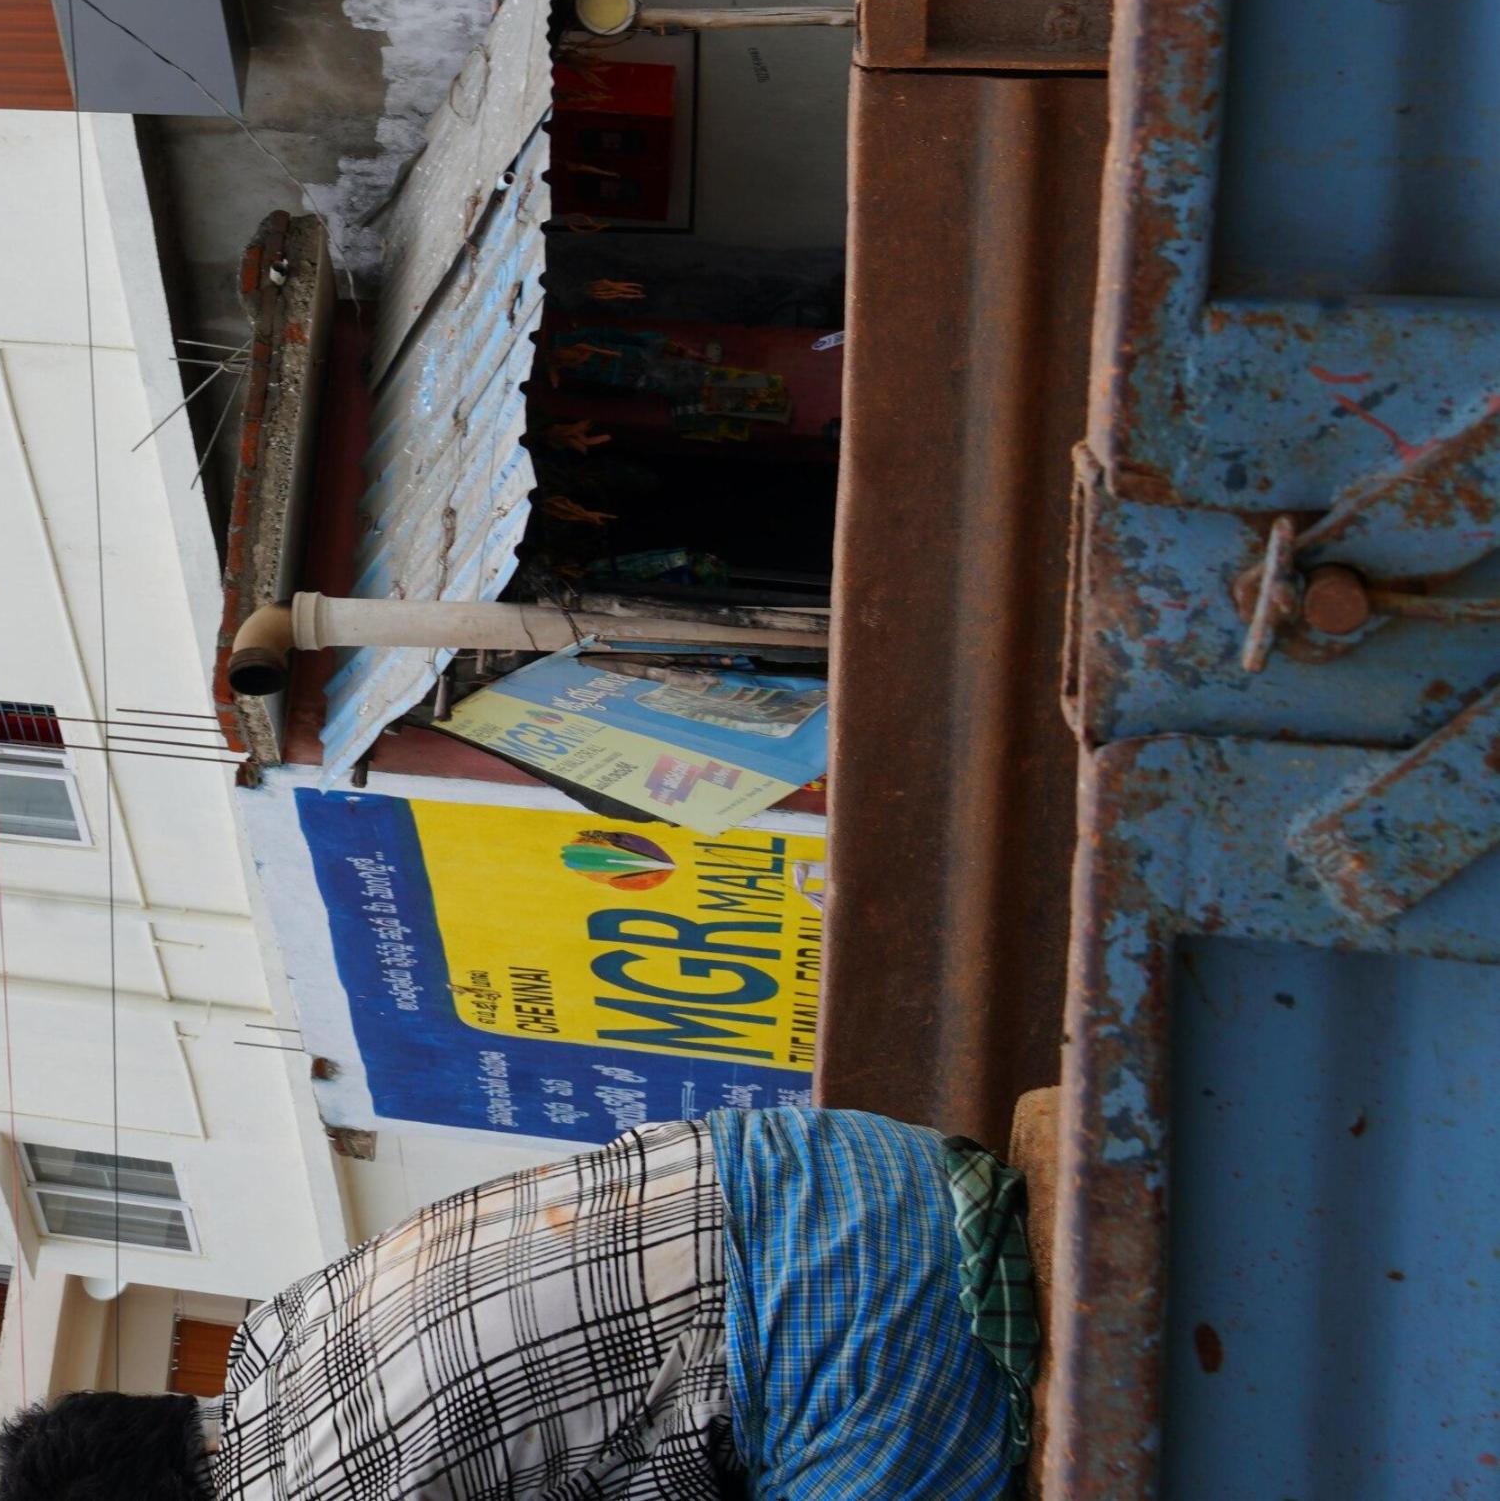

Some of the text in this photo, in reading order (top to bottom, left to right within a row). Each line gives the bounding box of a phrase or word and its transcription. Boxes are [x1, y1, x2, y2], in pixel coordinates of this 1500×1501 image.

[485, 722, 585, 767] MGR
[694, 837, 785, 917] MALL
[508, 966, 560, 1033] CHENNAI
[586, 908, 782, 1059] MGR
